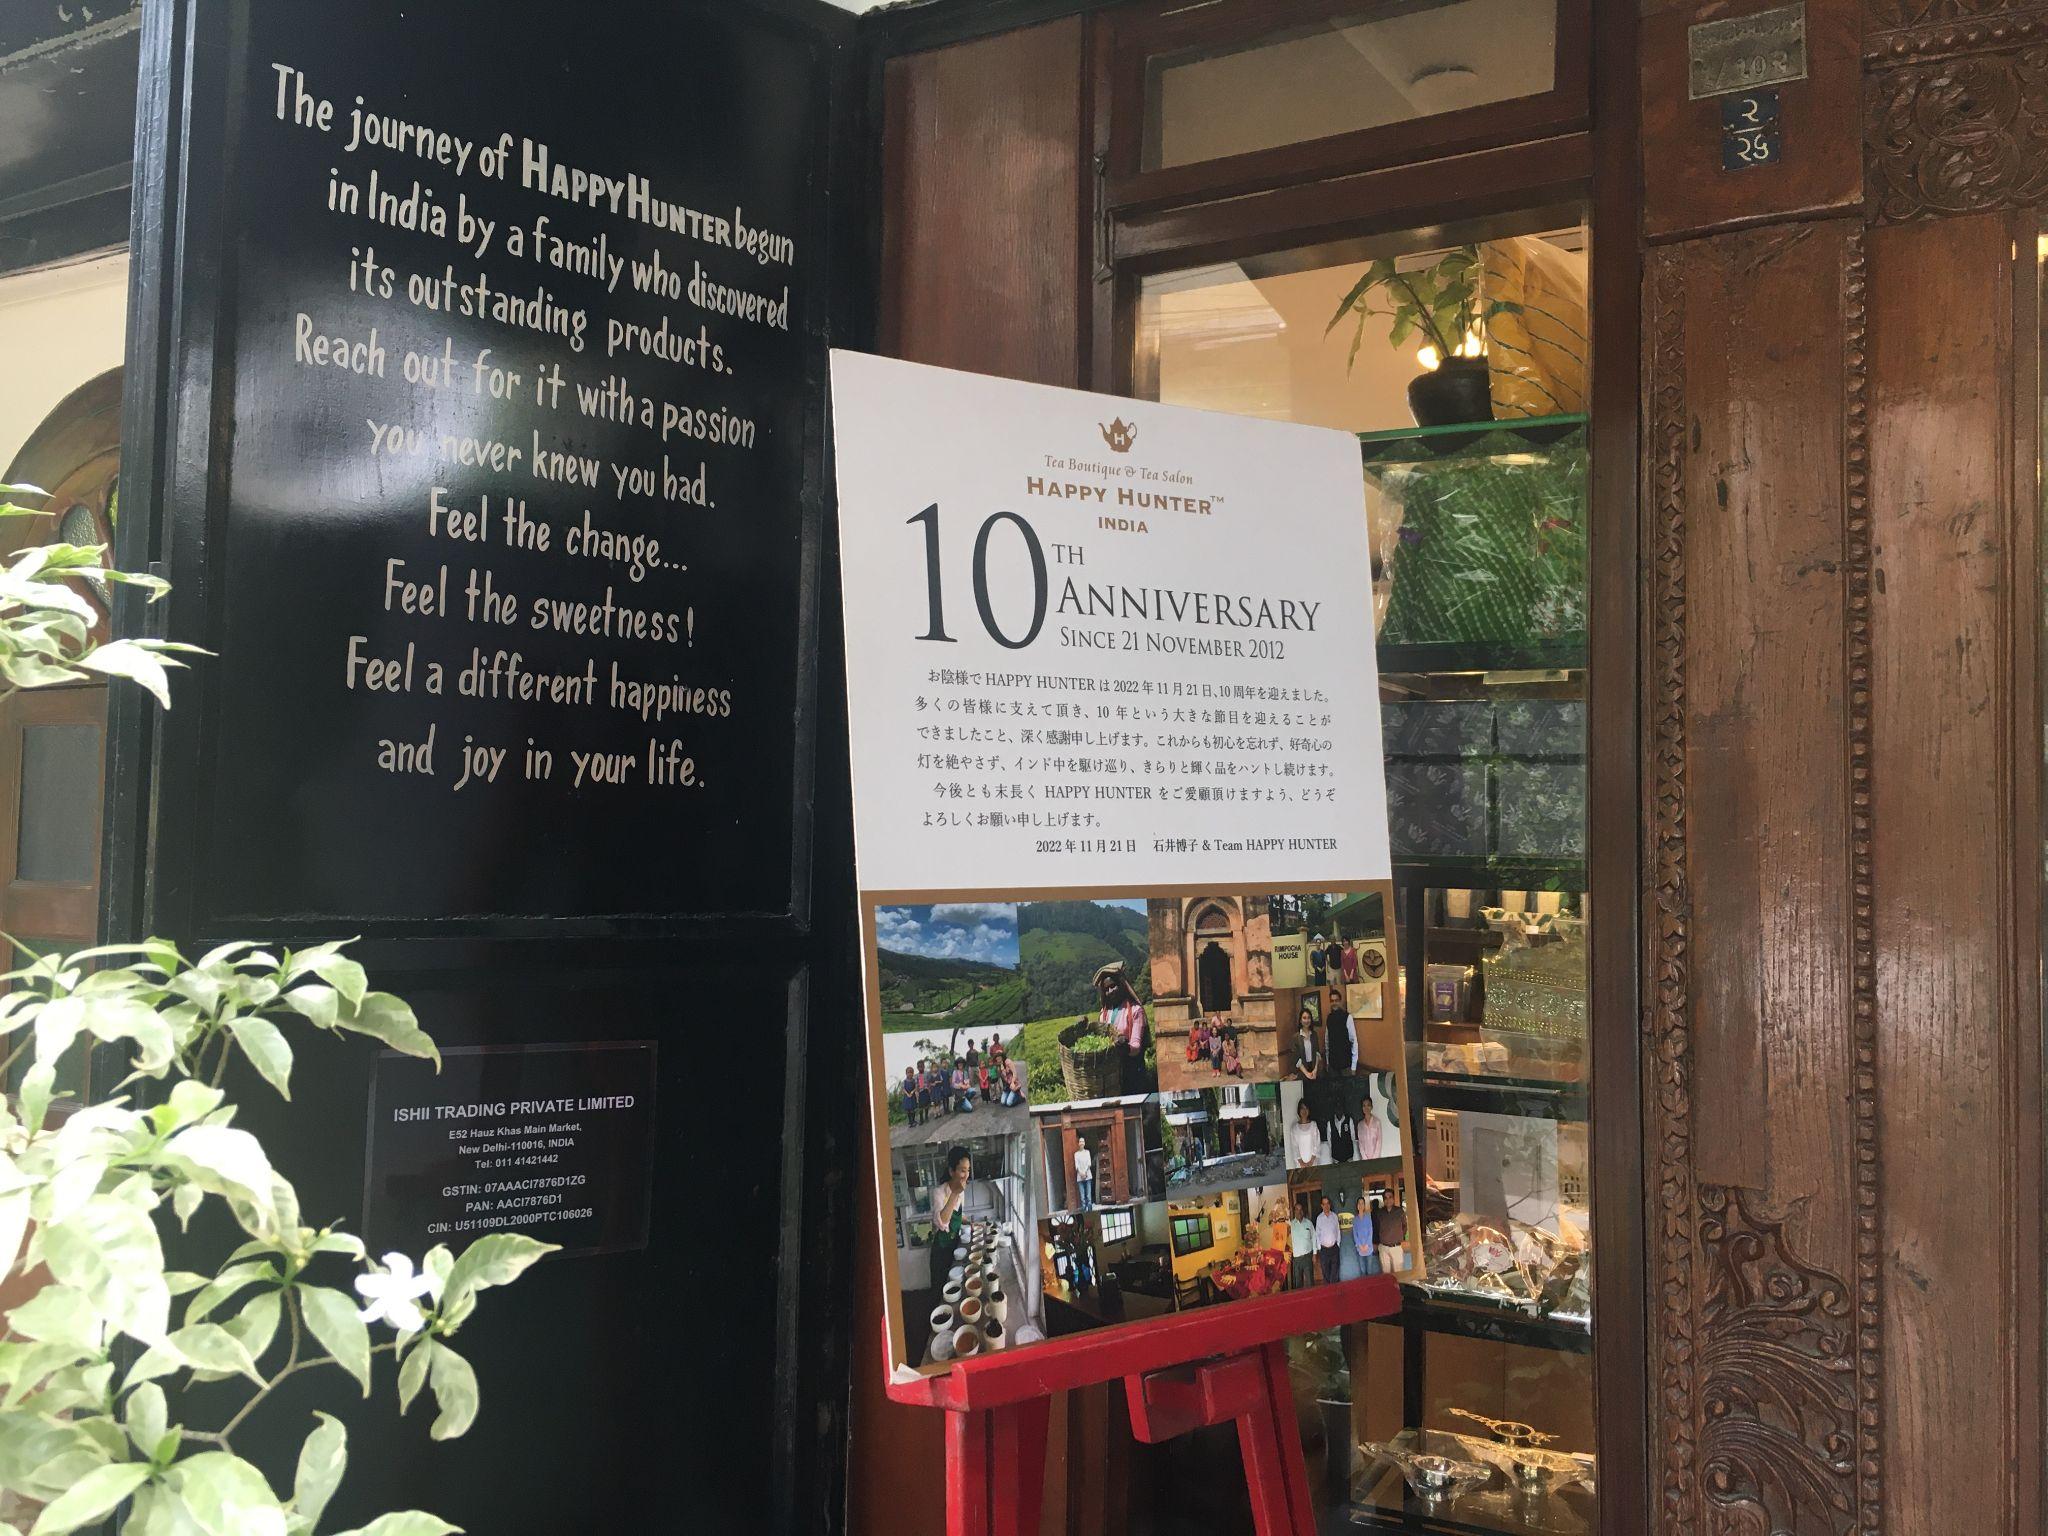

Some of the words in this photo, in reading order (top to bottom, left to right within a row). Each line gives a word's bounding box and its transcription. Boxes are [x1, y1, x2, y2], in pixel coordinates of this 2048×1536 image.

[272, 62, 334, 132] The
[344, 95, 473, 177] journey
[479, 132, 513, 180] of
[734, 206, 795, 266] begun
[327, 167, 359, 214] in
[369, 169, 447, 238] India
[457, 193, 496, 259] by
[506, 223, 525, 258] a
[531, 215, 625, 294] family
[631, 248, 682, 301] who
[687, 260, 789, 332] discovered
[348, 246, 396, 300] its
[407, 264, 587, 353] outstanding
[607, 315, 734, 375] products.
[294, 312, 385, 379] Reach
[403, 336, 458, 388] out
[472, 348, 521, 400] for
[536, 363, 566, 409] it
[577, 378, 634, 427] with
[639, 397, 655, 425] a
[662, 401, 756, 449] passion
[1114, 433, 1125, 446] H
[367, 418, 424, 457] you
[442, 435, 522, 472] never
[532, 430, 600, 488] knew
[611, 462, 655, 500] you
[662, 454, 716, 509] had.
[1044, 455, 1065, 469] Tea
[1068, 458, 1121, 480] Boutique
[1124, 466, 1137, 477] &
[1140, 467, 1159, 481] Tea
[1162, 470, 1193, 485] Salon
[1027, 476, 1107, 502] HAPPY
[428, 486, 488, 542] Feel
[502, 497, 550, 552] the
[565, 510, 688, 583] change...
[1098, 516, 1149, 534] INDIA
[906, 502, 1048, 649] 10
[1051, 543, 1086, 566] TH
[384, 558, 447, 618] Feel
[465, 568, 518, 626] the
[530, 585, 695, 649] sweetness!
[1056, 576, 1321, 631] ANNIVERSARY
[1060, 626, 1116, 650] SINCE
[1121, 629, 1139, 651] 21
[1146, 631, 1245, 658] NOVEMBER
[1249, 638, 1285, 660] 2012
[346, 635, 415, 693] Feel
[425, 661, 443, 695] a
[458, 647, 598, 706] different
[610, 661, 732, 722] happiness
[985, 673, 1032, 688] HAPPY
[1037, 675, 1096, 691] HUNTER
[377, 722, 436, 776] and
[453, 734, 507, 791] joy
[526, 738, 553, 781] in
[571, 750, 637, 789] your
[648, 737, 706, 789] life.
[1045, 785, 1090, 799] HAPPY
[1095, 786, 1151, 799] HUNTER
[1202, 840, 1211, 850] &
[1213, 839, 1243, 850] Team
[1246, 838, 1285, 851] HAPPY
[1288, 838, 1338, 850] HUNTER
[1279, 951, 1299, 960] HOUSE
[394, 1107, 430, 1122] ISHII
[435, 1102, 506, 1120] TRADING
[510, 1098, 574, 1115] PRIVATE
[578, 1095, 635, 1112] LIMITED
[449, 1130, 468, 1140] E52
[470, 1128, 494, 1138] Hauz
[497, 1127, 522, 1136] Khas
[524, 1125, 546, 1134] Main
[549, 1123, 582, 1132] Market,
[459, 1145, 480, 1154] New
[549, 1137, 575, 1148] INDIA
[475, 1159, 493, 1169] Tel:
[496, 1157, 512, 1167] 011
[442, 1185, 481, 1197] GSTIN:
[466, 1201, 494, 1213] PAN:
[427, 1222, 451, 1234] CIN:
